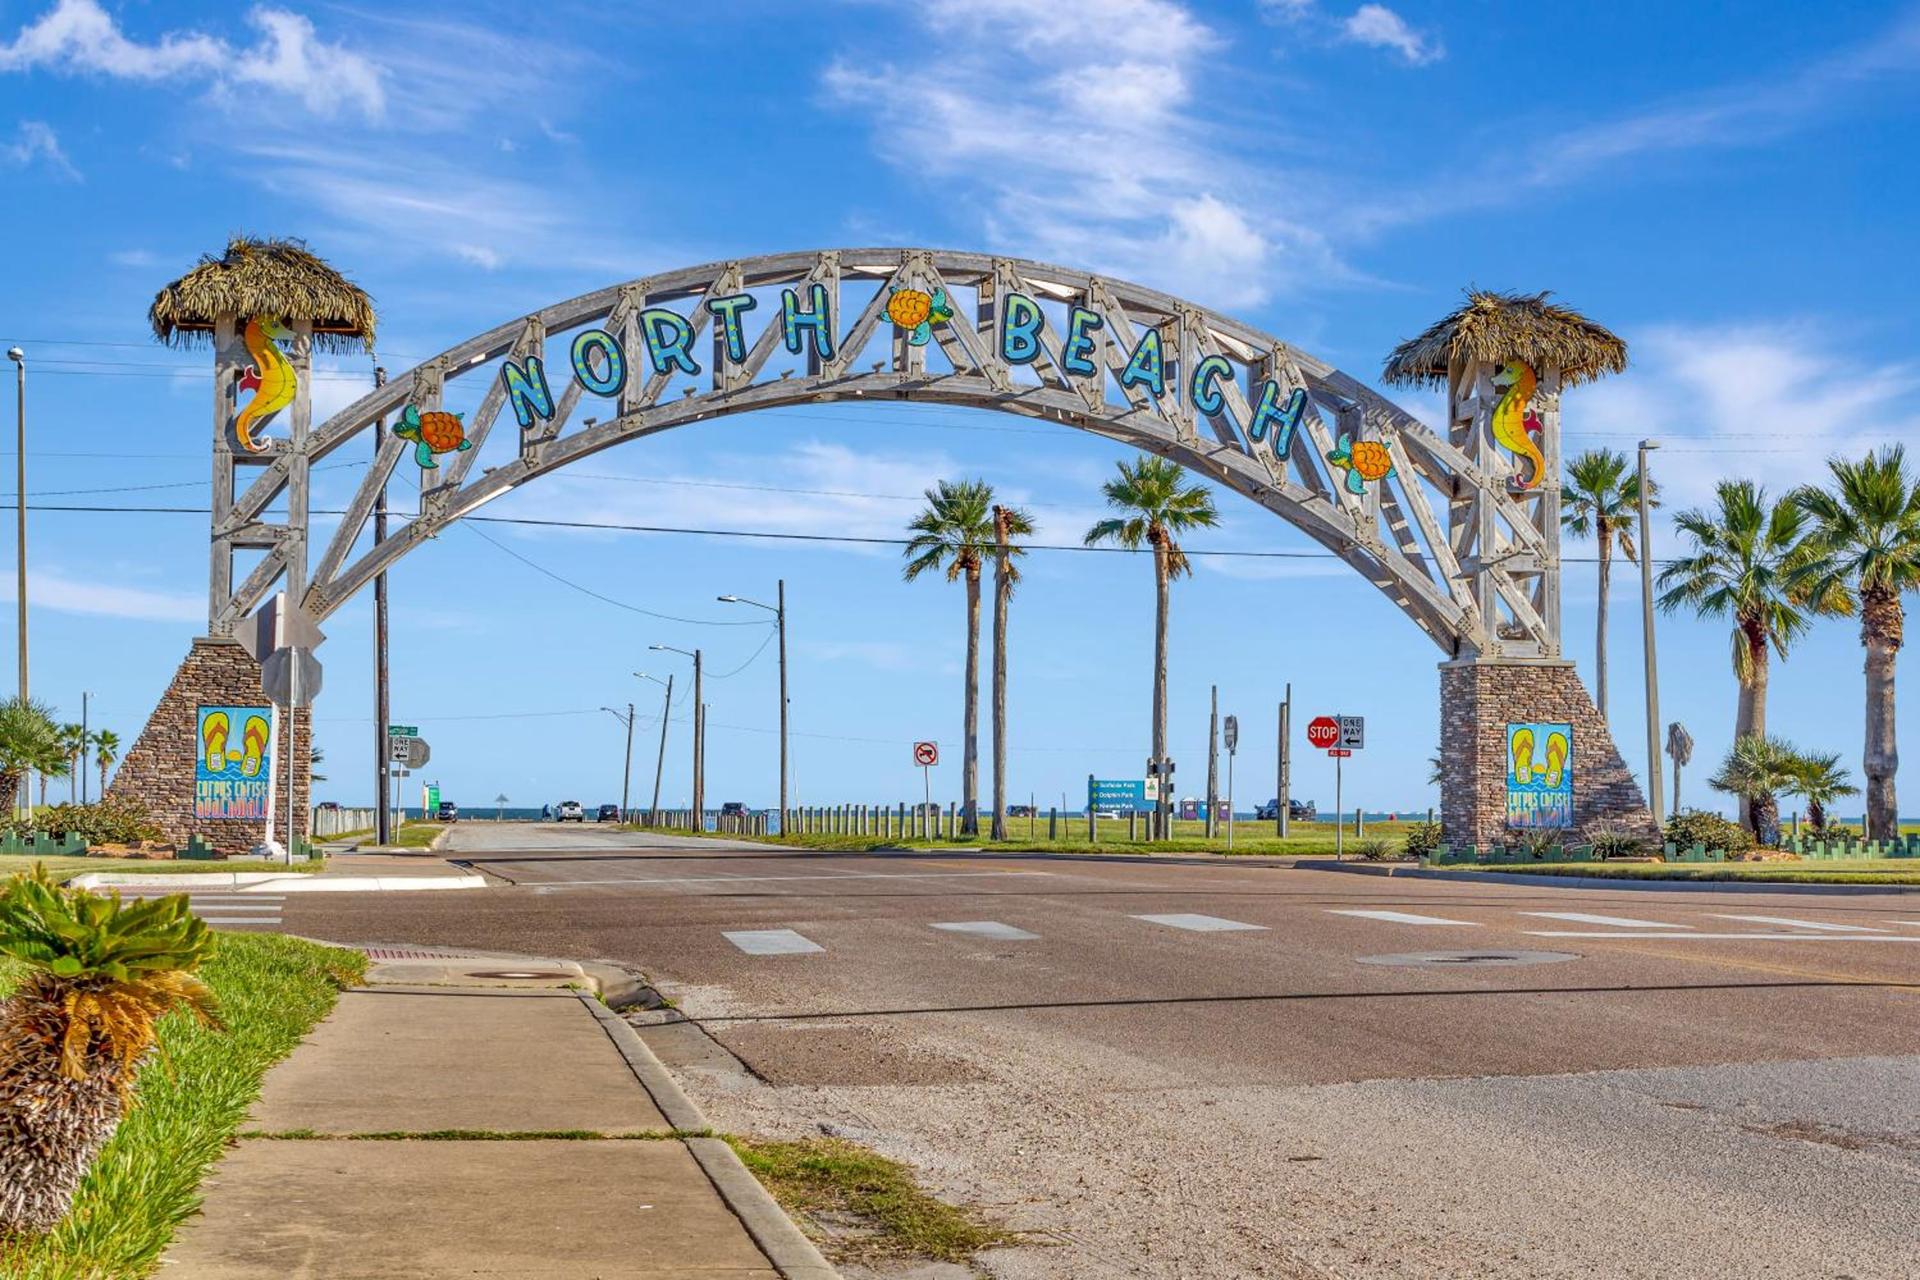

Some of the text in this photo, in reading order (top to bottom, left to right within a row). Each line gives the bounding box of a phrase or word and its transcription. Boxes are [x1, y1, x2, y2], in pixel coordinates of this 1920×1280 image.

[502, 283, 1308, 462] NORTH BEACH
[1343, 718, 1361, 727] ONE
[1309, 726, 1337, 739] STOP
[1343, 728, 1361, 736] WAY
[1099, 791, 1121, 799] Dolphin
